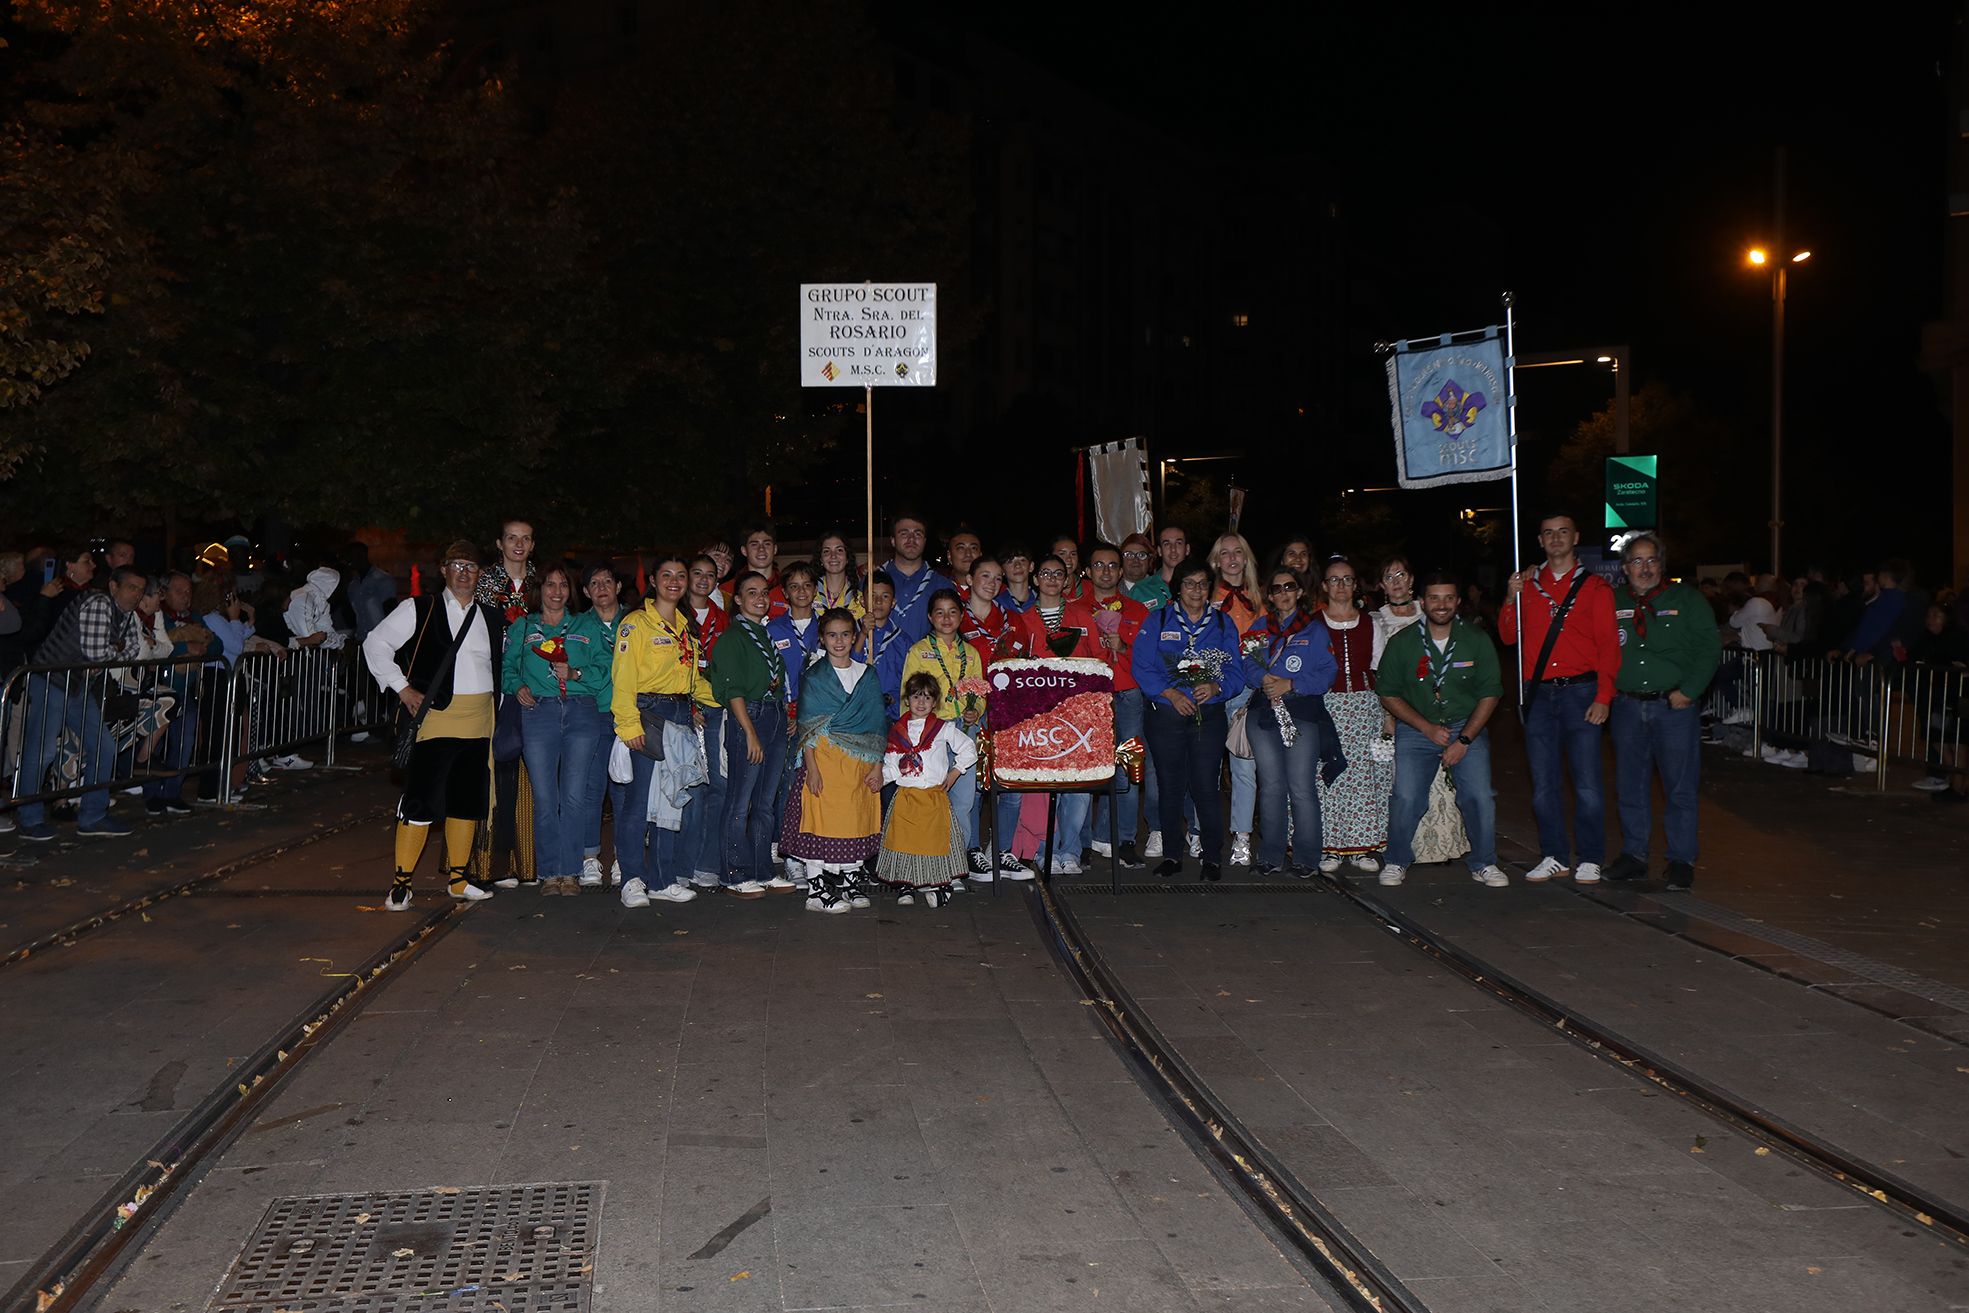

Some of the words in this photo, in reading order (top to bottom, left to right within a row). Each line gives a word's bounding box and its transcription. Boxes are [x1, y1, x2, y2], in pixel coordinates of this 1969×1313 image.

[808, 288, 866, 302] GRUPO
[873, 288, 928, 302] SCOUT
[830, 325, 906, 340] ROSARIO
[808, 347, 855, 358] SCOUTS
[850, 365, 886, 376] M.S.C.
[1015, 676, 1077, 689] SCOUTS
[1018, 726, 1064, 748] MSC
